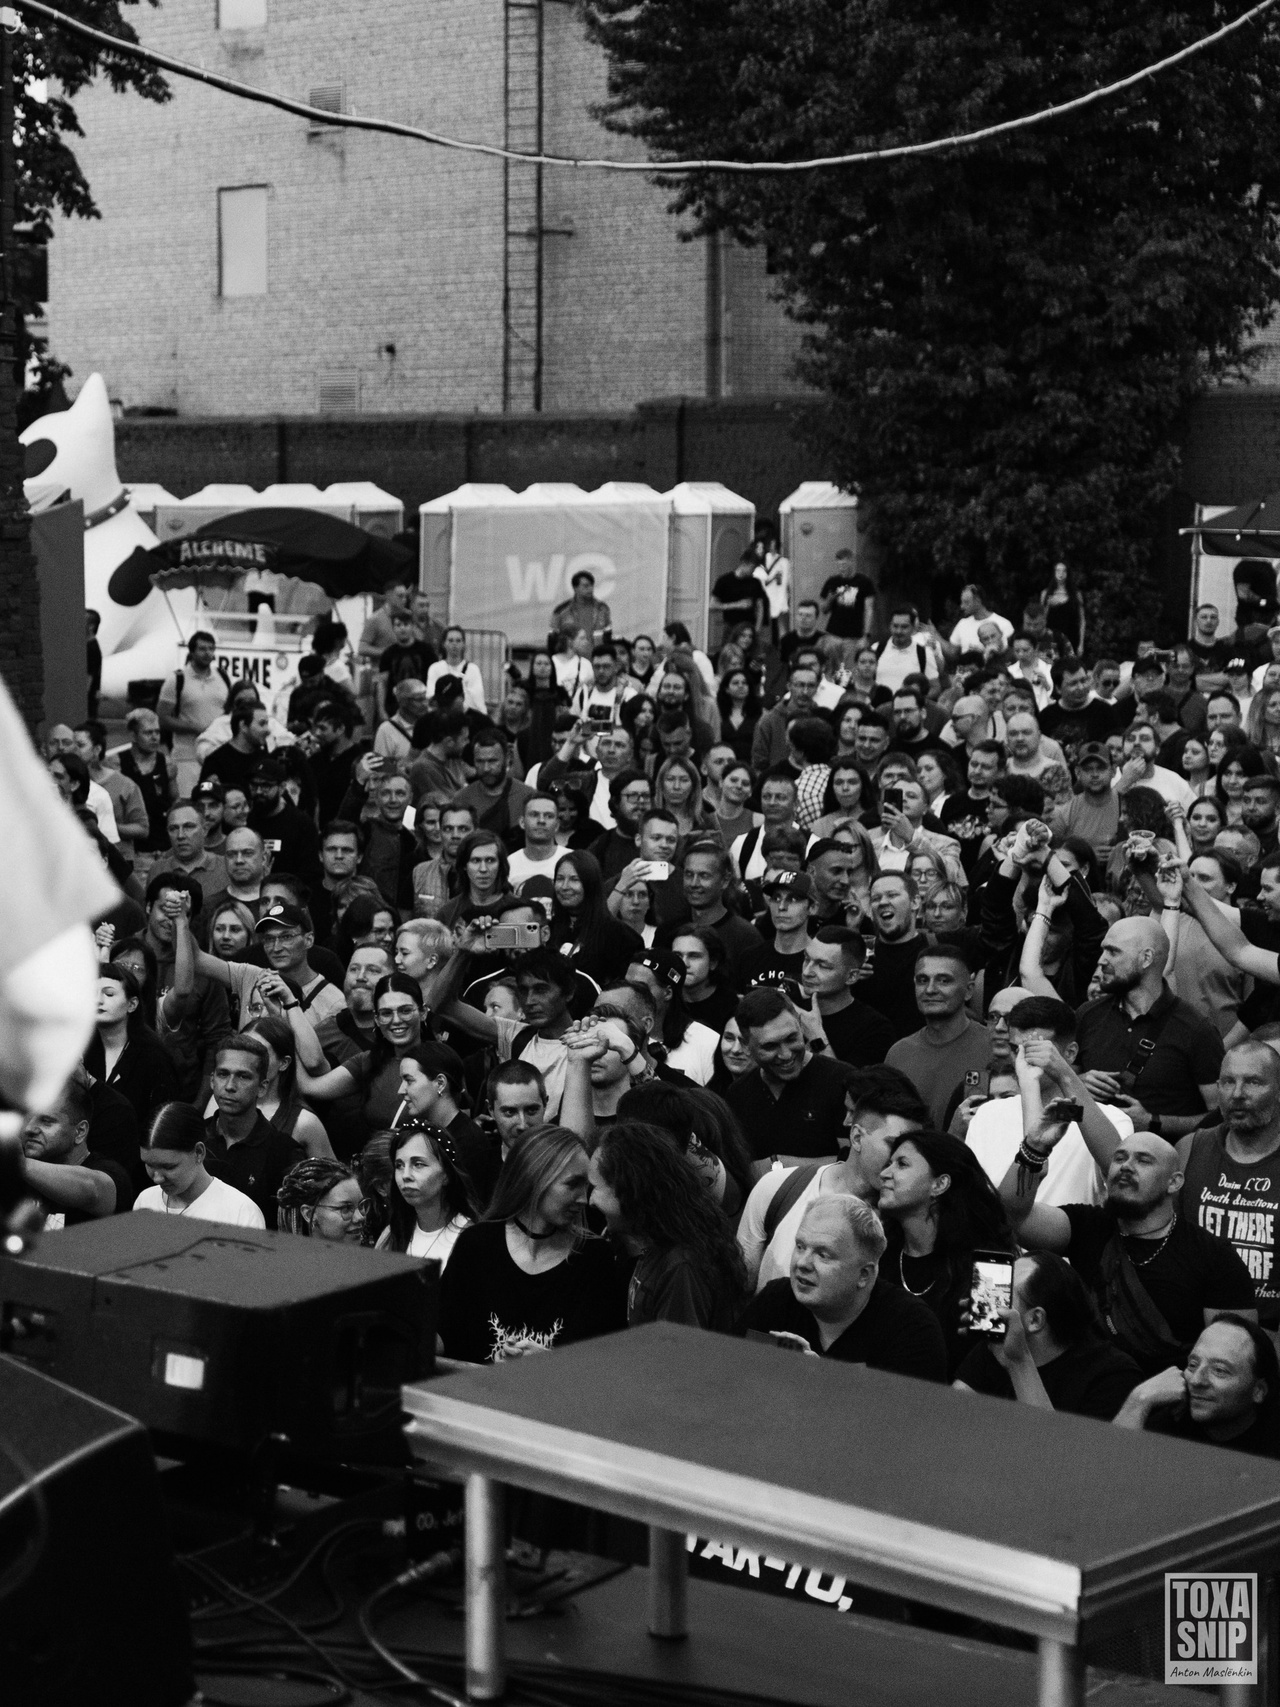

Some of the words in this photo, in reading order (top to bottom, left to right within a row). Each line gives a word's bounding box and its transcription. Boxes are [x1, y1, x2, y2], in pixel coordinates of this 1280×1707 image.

[505, 552, 617, 603] WC
[1200, 1186, 1231, 1204] Youth
[1227, 1209, 1275, 1245] THERE
